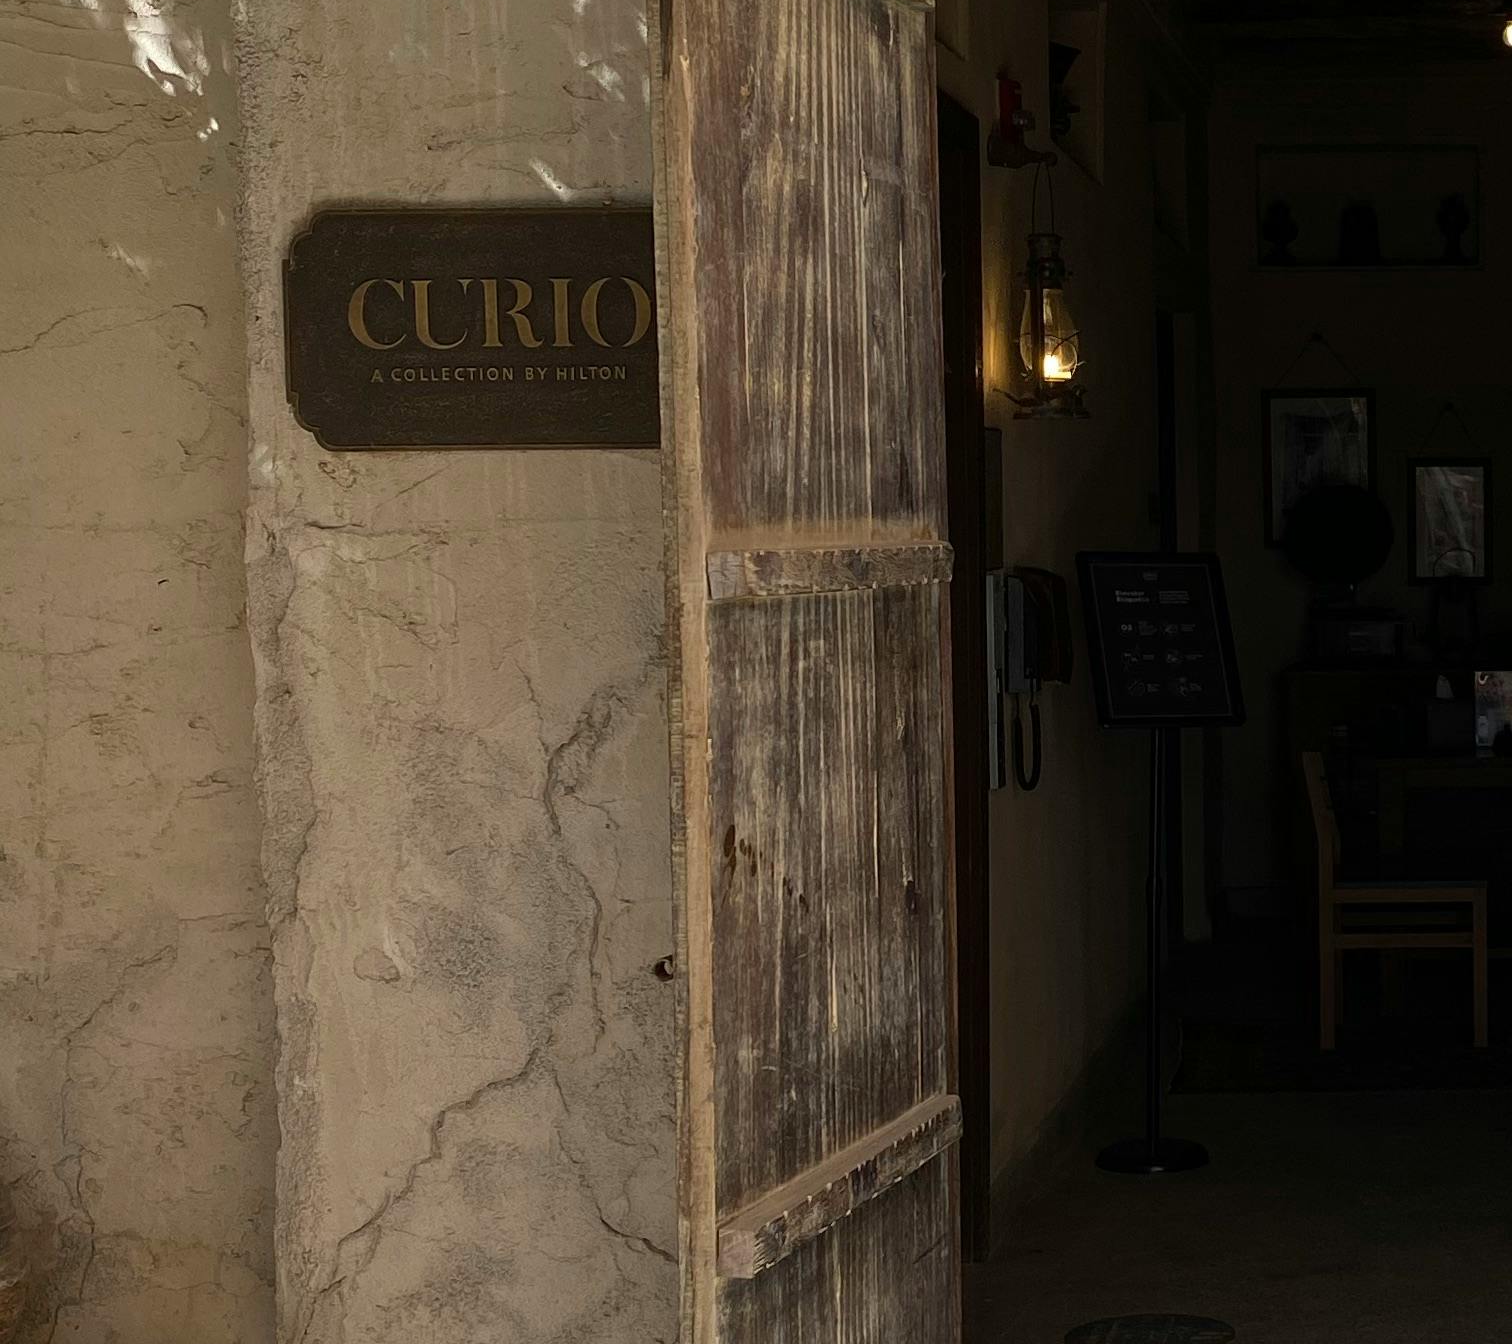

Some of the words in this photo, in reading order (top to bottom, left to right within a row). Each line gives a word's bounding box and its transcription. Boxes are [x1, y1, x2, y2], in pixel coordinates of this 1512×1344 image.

[347, 277, 653, 351] CURIO
[370, 368, 384, 384] A
[390, 367, 514, 383] COLLECTION
[525, 366, 549, 381] BY
[556, 365, 627, 381] HILTON
